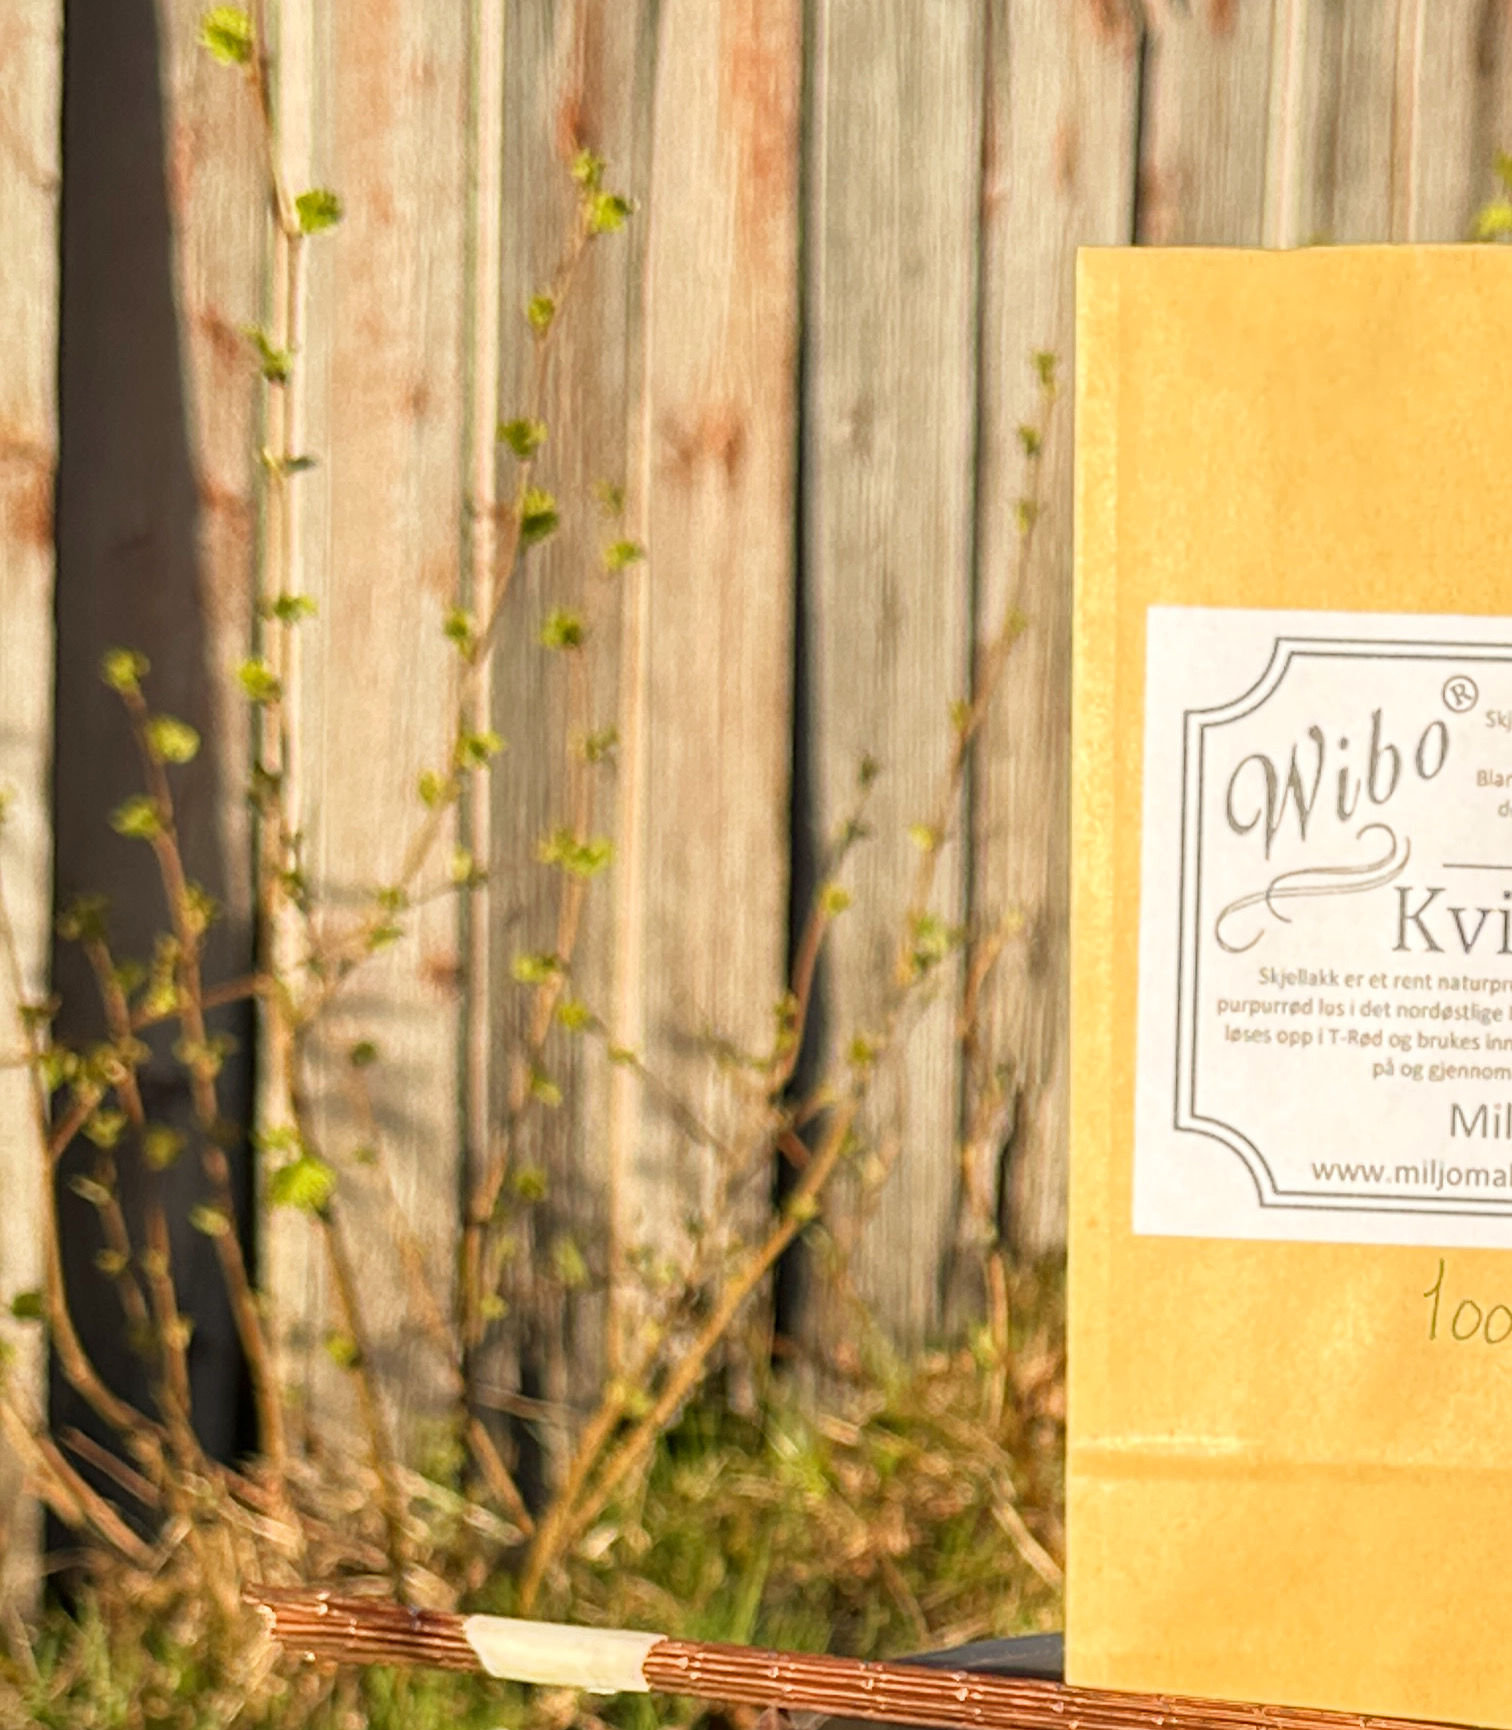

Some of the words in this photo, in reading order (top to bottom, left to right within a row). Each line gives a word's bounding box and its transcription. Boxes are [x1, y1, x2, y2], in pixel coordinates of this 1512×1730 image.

[1258, 967, 1339, 989] Skjellakk
[1344, 972, 1364, 988] er
[1369, 973, 1387, 988] et
[1393, 973, 1432, 990] rent
[1217, 998, 1313, 1017] purpurrød
[1360, 1002, 1391, 1018] det
[1397, 1002, 1503, 1025] nordøstlige
[1225, 1025, 1272, 1043] løses
[1277, 1030, 1313, 1047] opp
[1328, 1029, 1382, 1046] T-Rød
[1389, 1034, 1412, 1051] og
[1417, 1032, 1480, 1050] brukes
[1373, 1058, 1394, 1080] på
[1400, 1064, 1424, 1081] og
